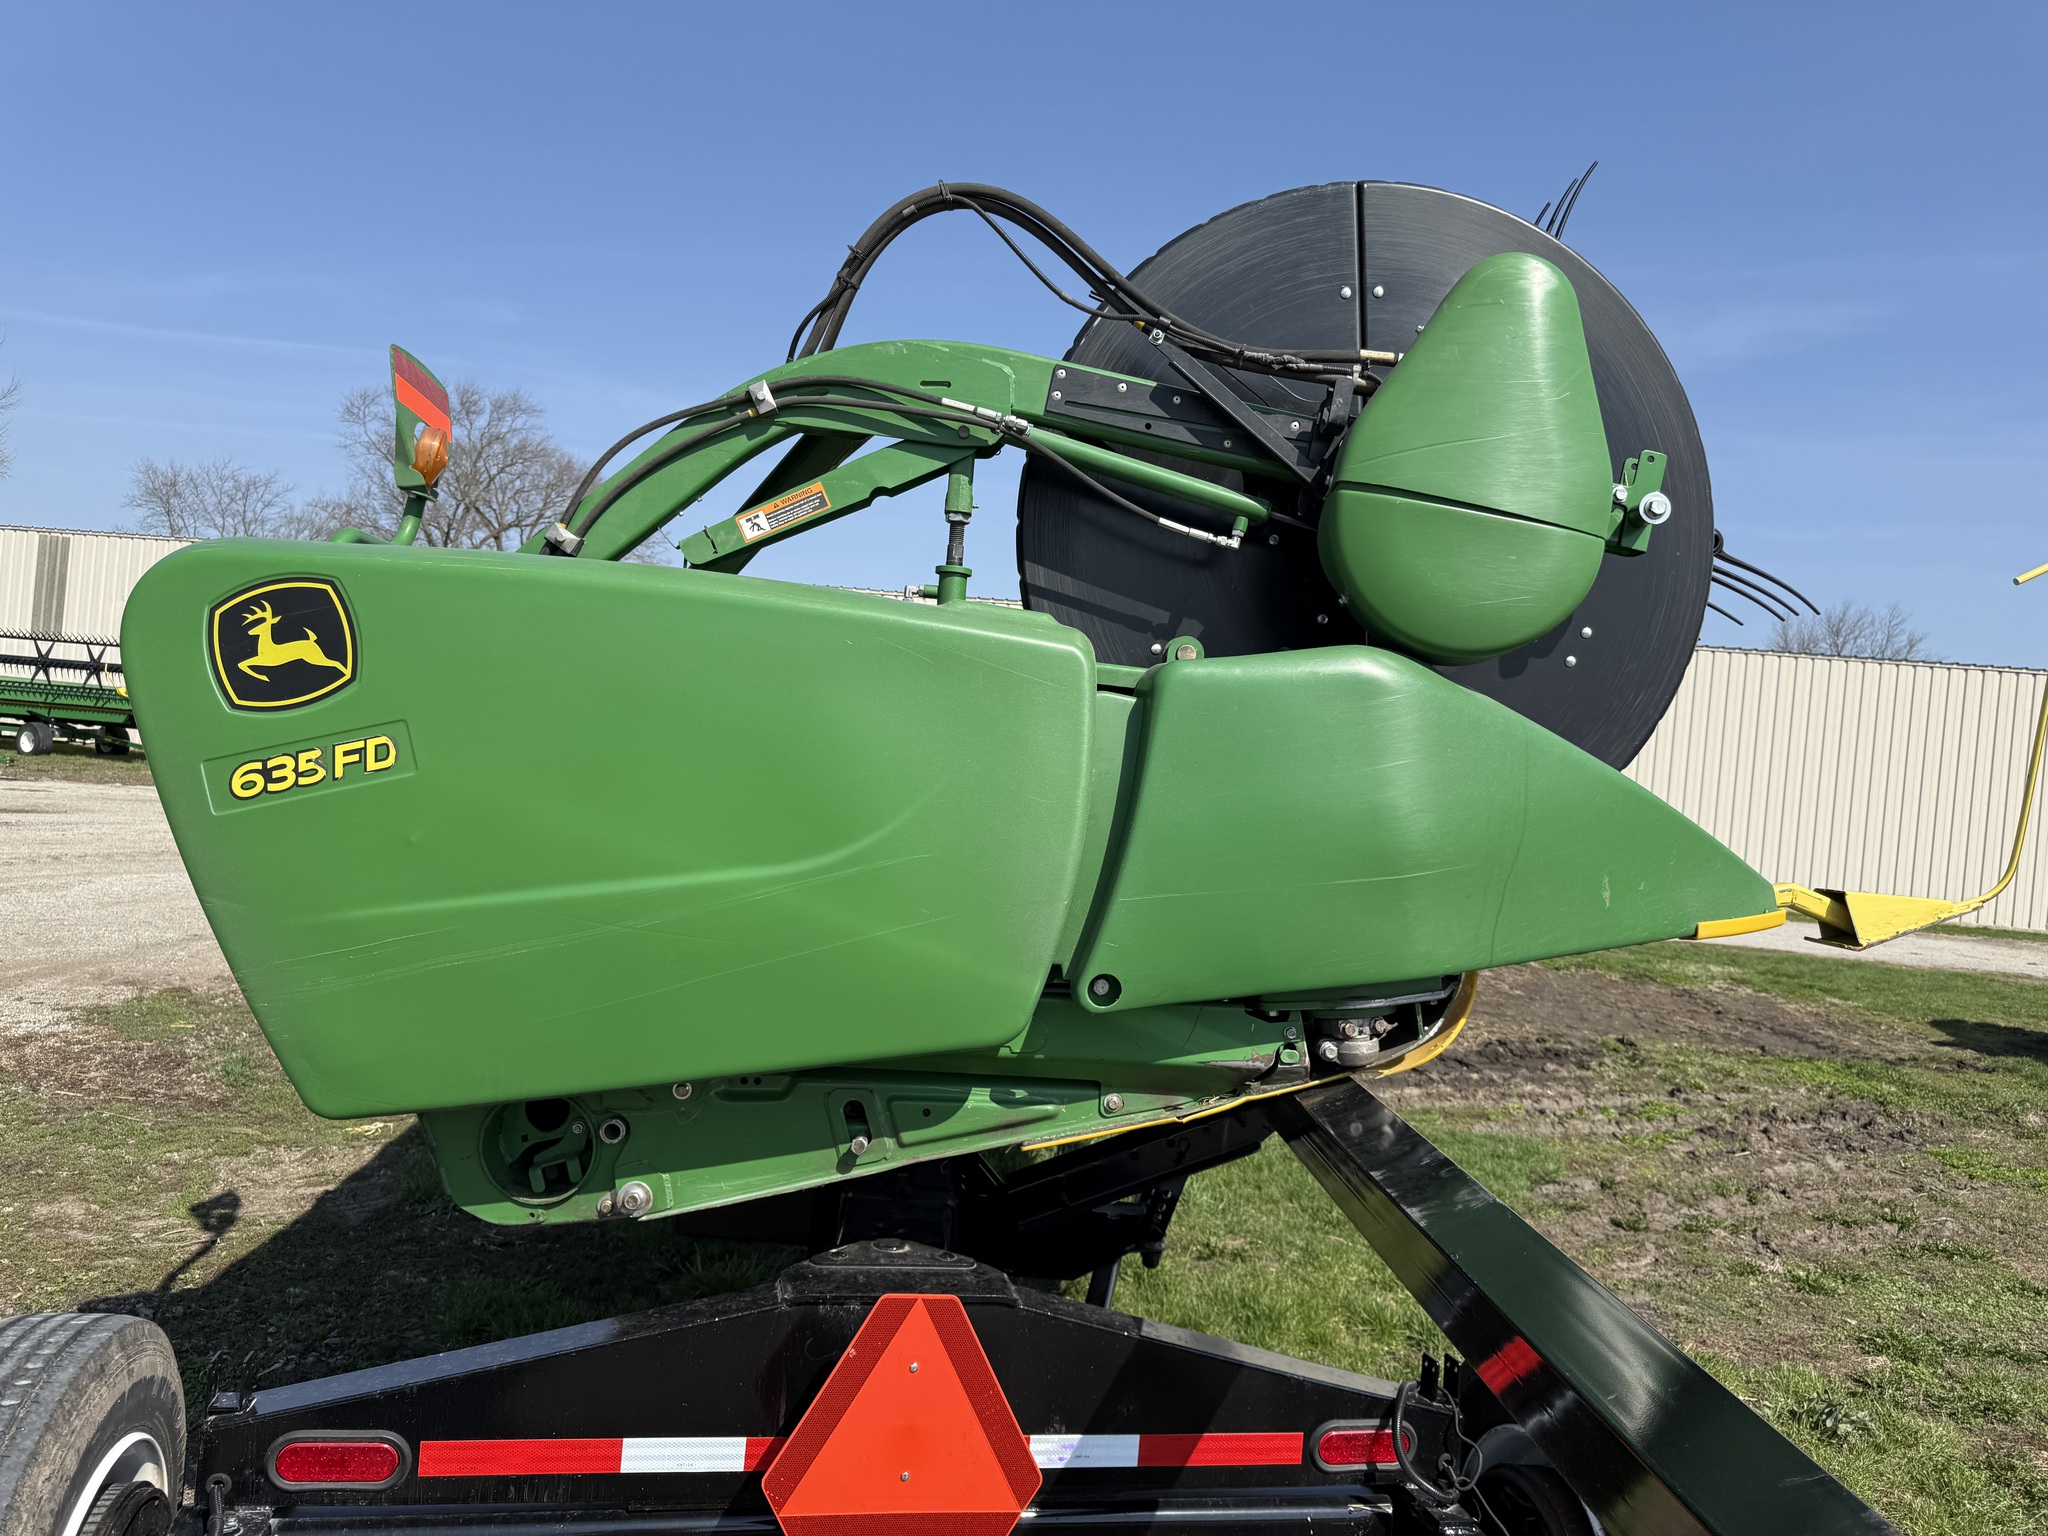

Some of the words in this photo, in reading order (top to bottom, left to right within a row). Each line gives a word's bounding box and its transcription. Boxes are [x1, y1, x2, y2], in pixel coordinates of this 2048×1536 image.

[780, 487, 813, 505] WARNING
[230, 747, 327, 800] 635
[332, 734, 397, 781] FD
